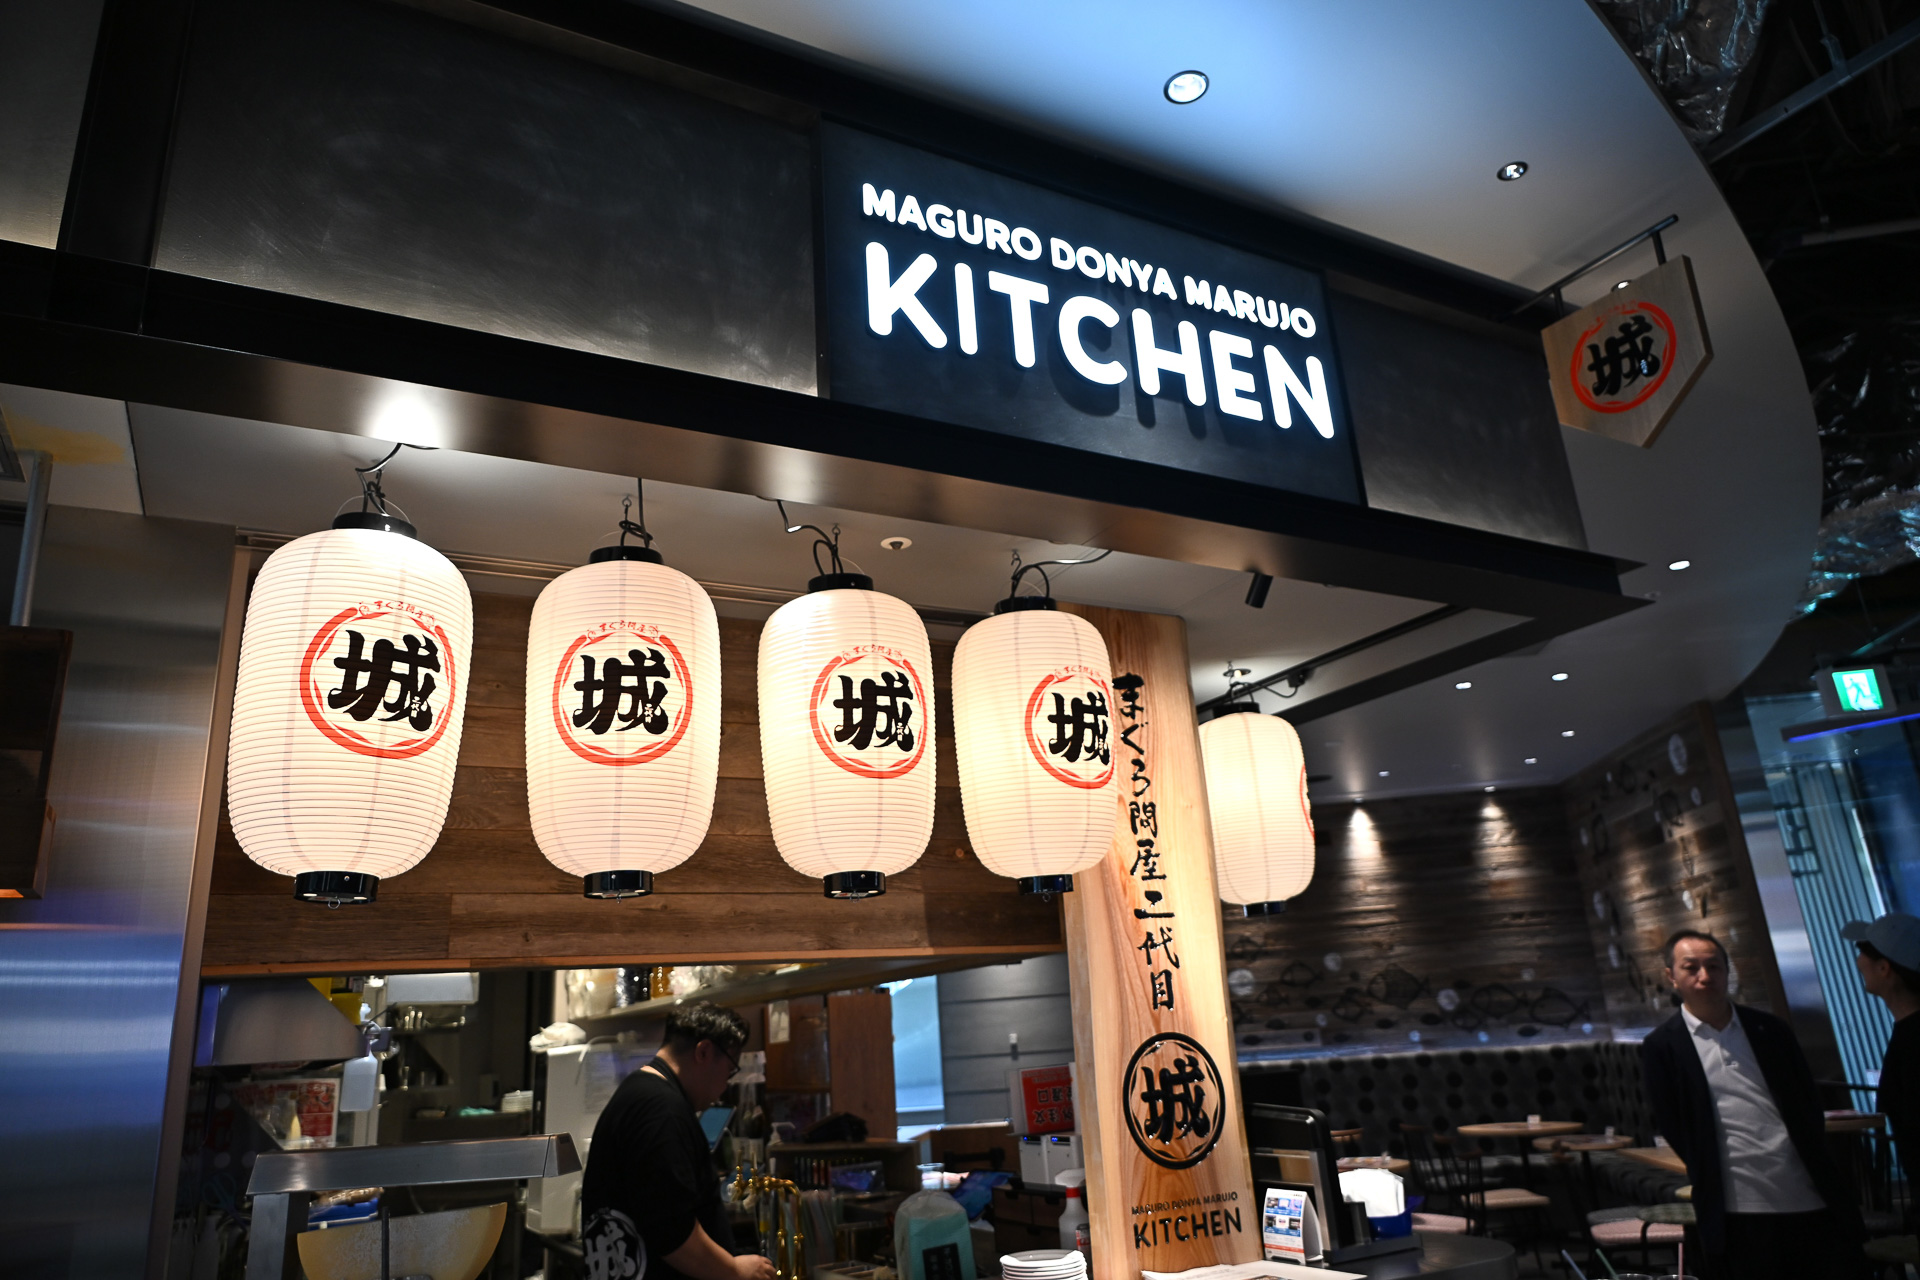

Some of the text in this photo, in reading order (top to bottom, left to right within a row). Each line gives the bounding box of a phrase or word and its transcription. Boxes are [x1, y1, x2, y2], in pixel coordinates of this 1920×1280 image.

[862, 183, 1317, 338] MAGURO DONYA MARUJO
[865, 241, 1335, 439] KITCHEN
[1587, 315, 1660, 397] 城
[327, 629, 441, 732] 城
[572, 646, 671, 735] 城
[832, 669, 915, 752] 城
[1047, 690, 1110, 766] 城
[1112, 672, 1181, 1012] まぐろ問屋二代目
[1140, 1053, 1211, 1145] 城
[1131, 1191, 1238, 1215] MAGURO DONYA MARUJO
[1133, 1207, 1242, 1250] KITCHEN
